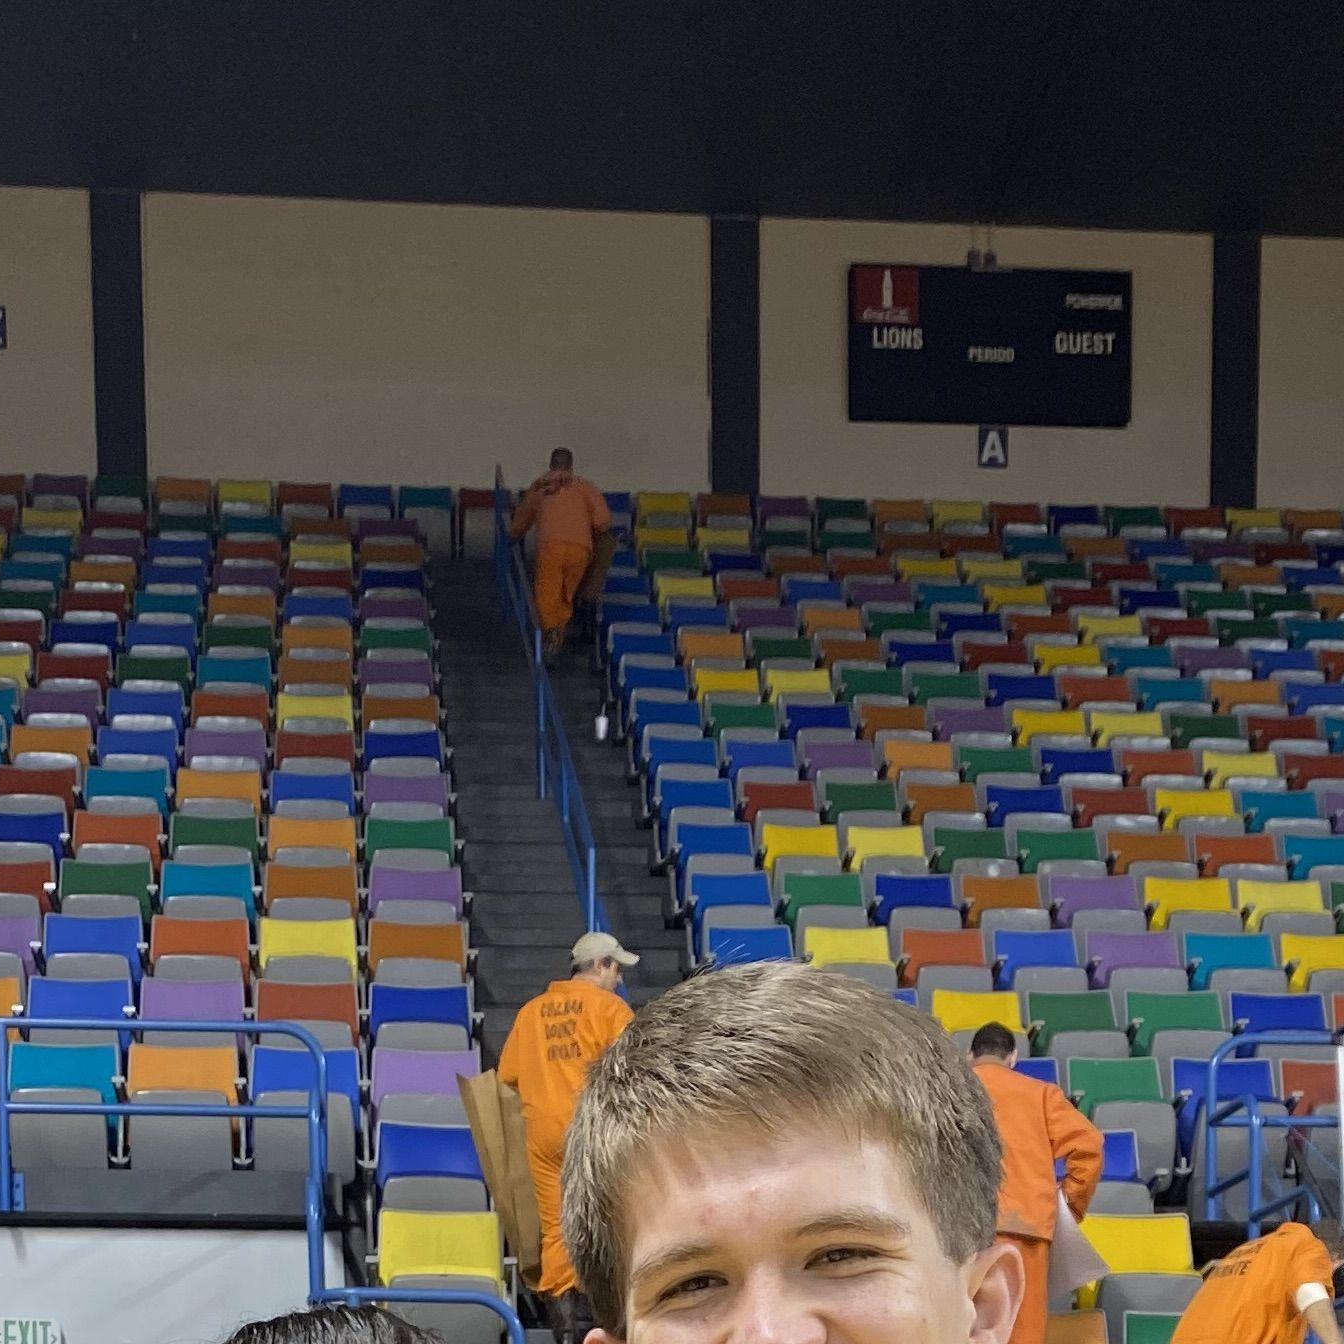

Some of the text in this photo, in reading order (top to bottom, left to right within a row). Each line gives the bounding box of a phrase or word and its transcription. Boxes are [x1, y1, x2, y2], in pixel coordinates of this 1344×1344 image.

[871, 325, 924, 350] LIONS
[1055, 330, 1116, 356] GUEST
[980, 430, 1006, 465] A
